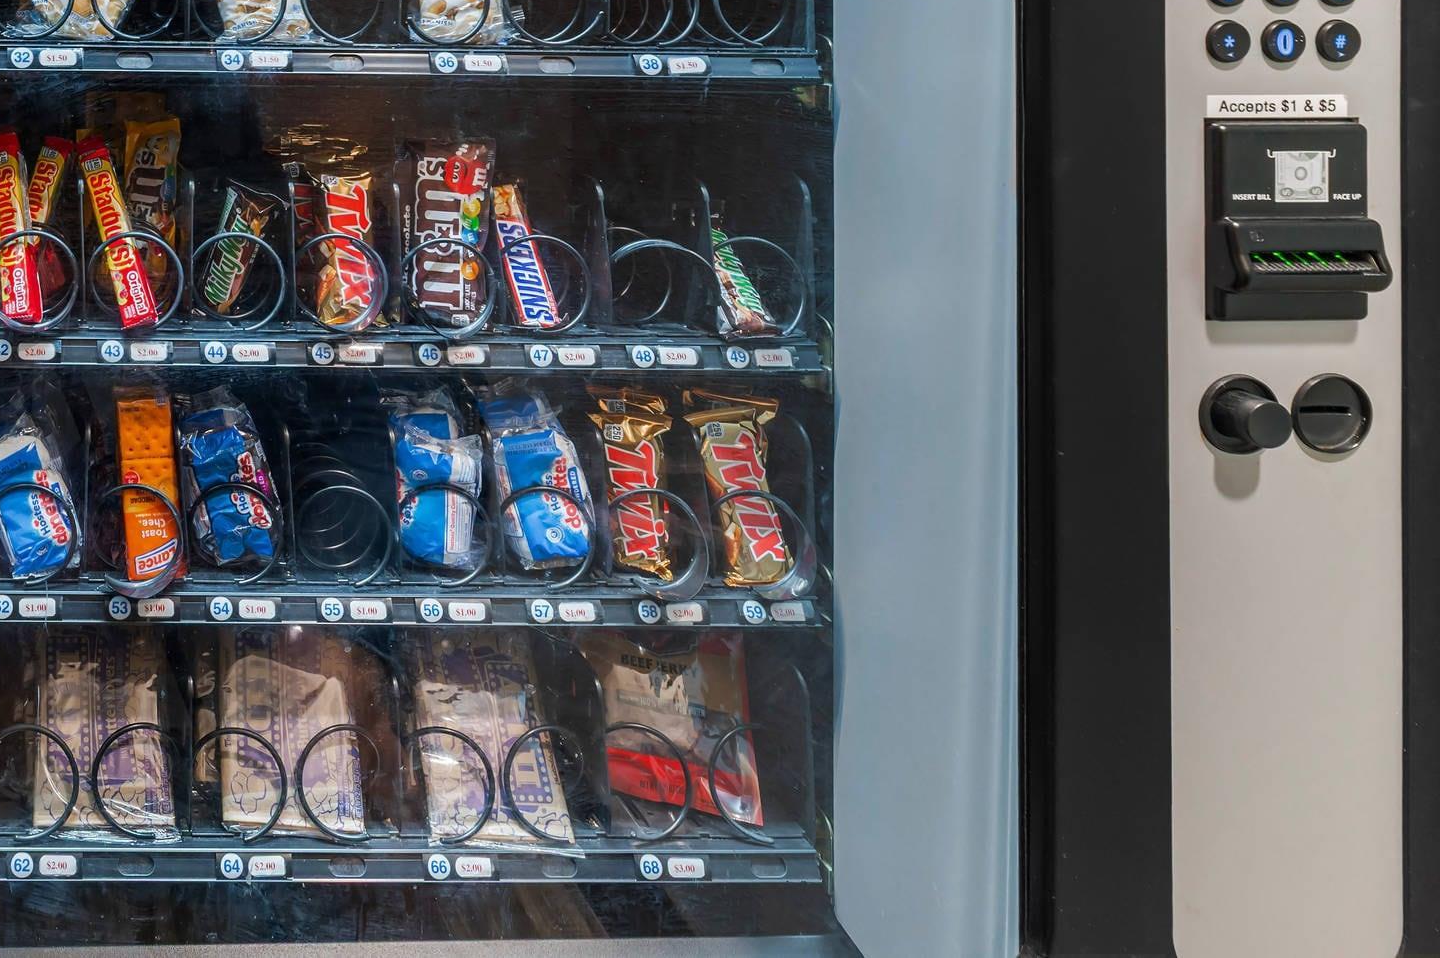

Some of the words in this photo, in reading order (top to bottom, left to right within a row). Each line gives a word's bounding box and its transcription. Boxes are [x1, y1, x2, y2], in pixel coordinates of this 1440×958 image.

[1276, 28, 1294, 56] 0
[14, 51, 30, 62] 32
[46, 54, 68, 62] $1.50
[1219, 100, 1276, 114] Accepts
[1281, 99, 1297, 113] $1
[1304, 100, 1314, 112] &
[1319, 99, 1337, 112] $5
[12, 268, 27, 312] Original
[126, 270, 148, 315] Original
[613, 426, 621, 441] 250
[713, 422, 721, 437] 250
[30, 493, 50, 536] Hostess
[142, 529, 168, 539] Toast
[620, 654, 653, 668] BEEF
[13, 858, 30, 872] 62
[46, 860, 67, 870] $2.00
